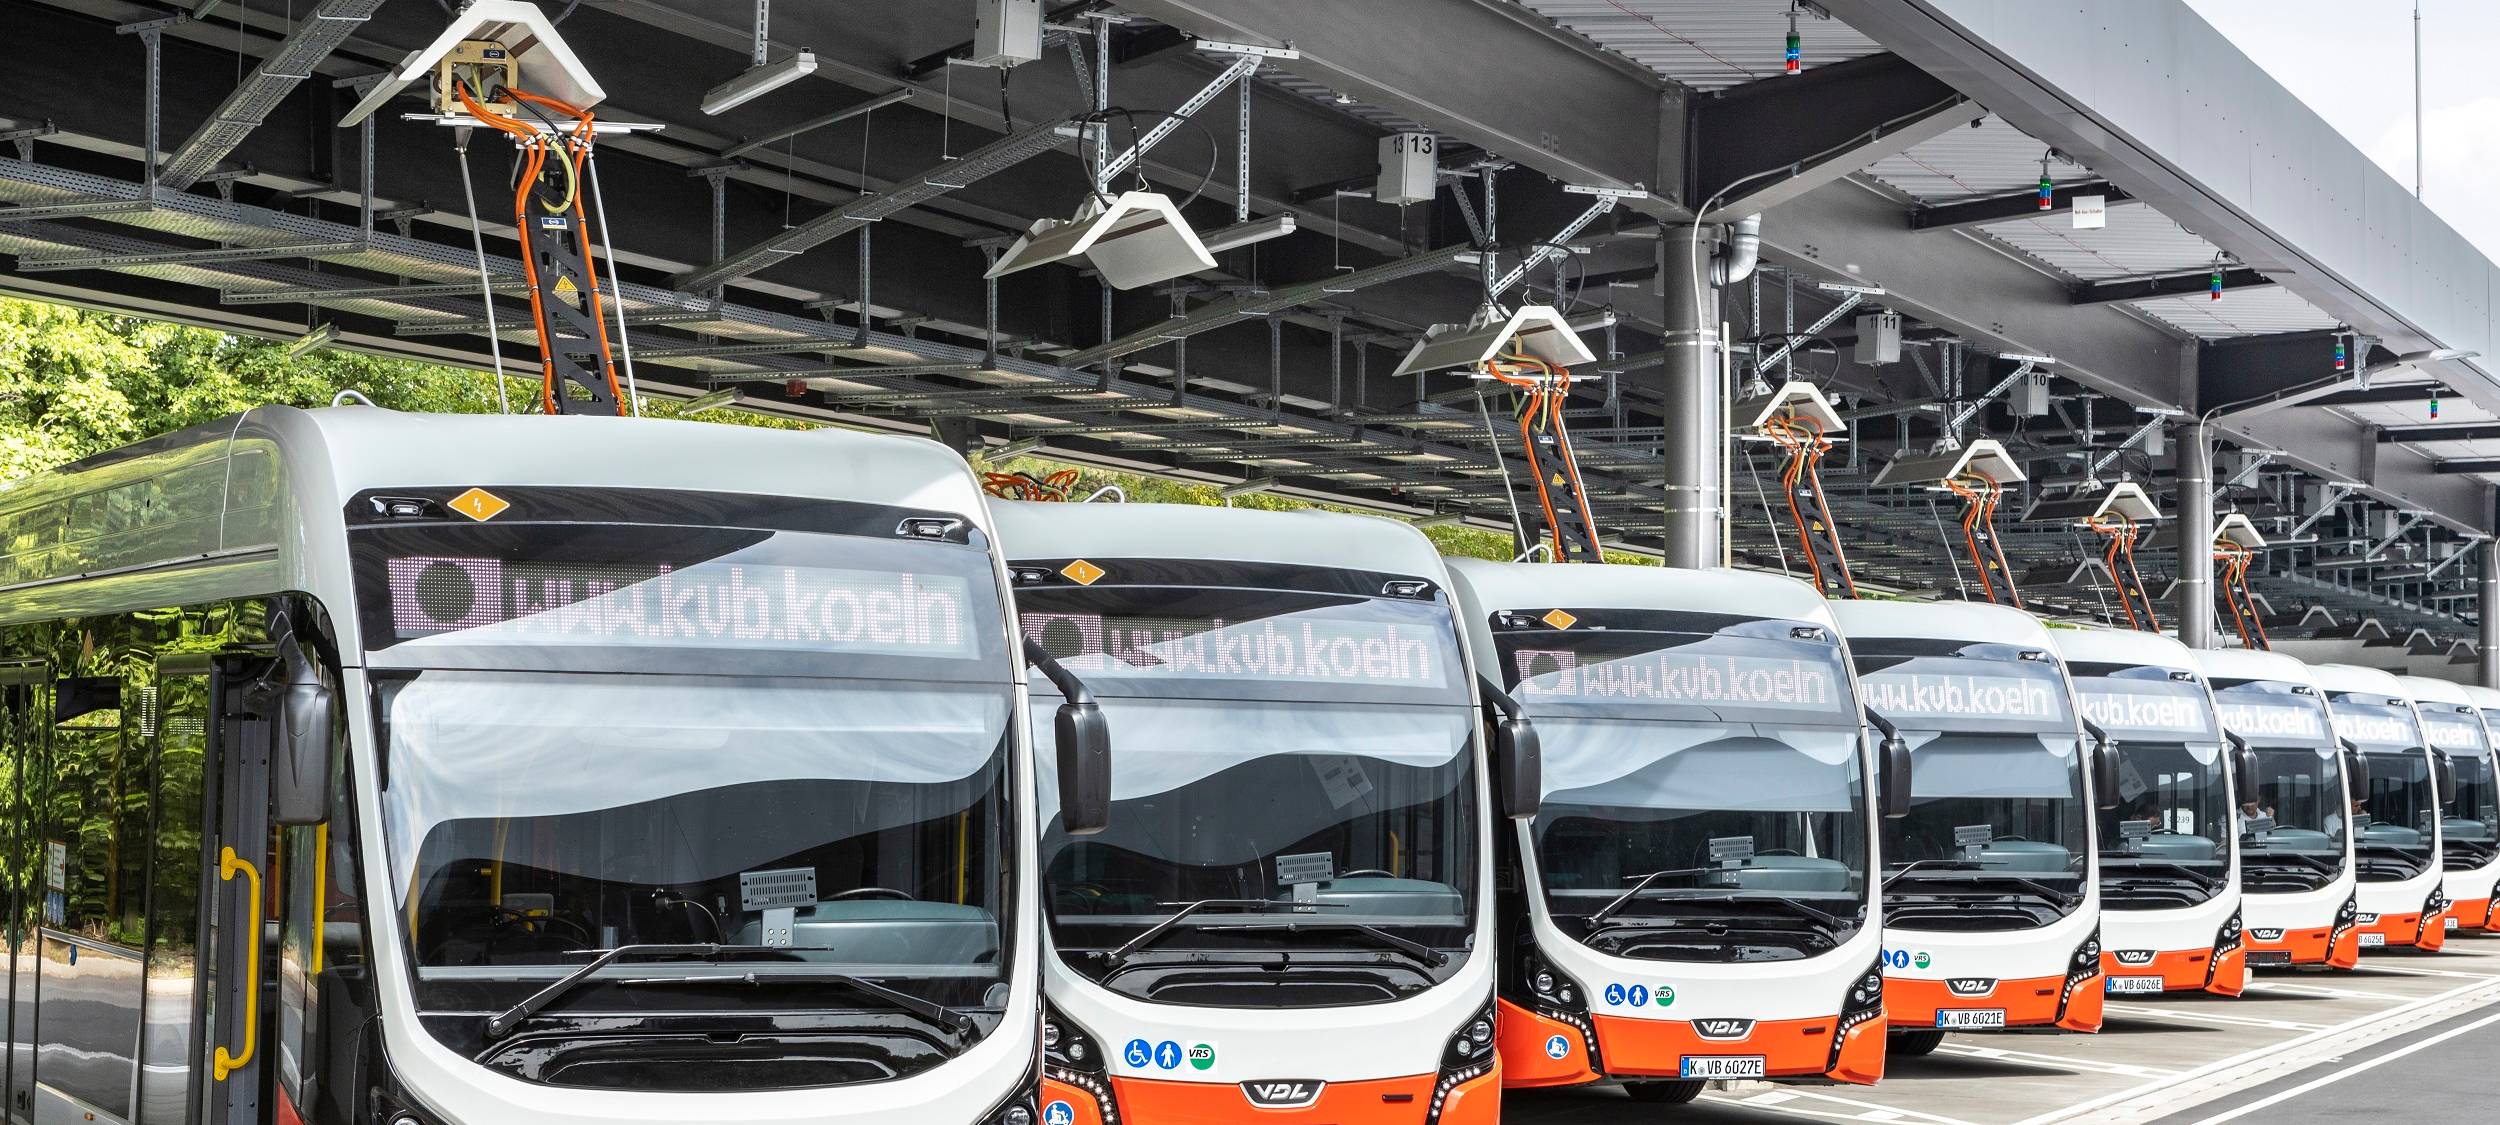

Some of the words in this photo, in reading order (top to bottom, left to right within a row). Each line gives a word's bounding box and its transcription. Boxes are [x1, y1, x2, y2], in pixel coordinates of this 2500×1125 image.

[1393, 136, 1403, 154] 13
[1411, 135, 1432, 154] 13
[1870, 315, 1878, 328] 11
[1883, 316, 1896, 330] 11
[2033, 374, 2047, 386] 10
[2328, 485, 2334, 495] 7
[514, 564, 962, 645] www.kvb.koeln
[1111, 619, 1431, 679] www.kvb.koeln
[1582, 655, 1825, 703] www.kvb.koeln
[2254, 929, 2279, 938] VDL
[2120, 951, 2149, 961] VDL
[1953, 980, 1988, 991] VDL
[2112, 979, 2118, 990] K
[2124, 979, 2135, 990] VB
[2136, 979, 2161, 990] 6026E
[1654, 990, 1671, 998] VRS
[1944, 1012, 1951, 1025] K
[1958, 1012, 1970, 1025] VB
[1972, 1012, 2003, 1025] 6021E
[1701, 1021, 1744, 1034] VDL
[1188, 1049, 1209, 1058] VRS
[1690, 1060, 1698, 1075] K
[1707, 1060, 1722, 1075] VB
[1725, 1060, 1762, 1075] 6027E
[1253, 1083, 1309, 1100] VDL
